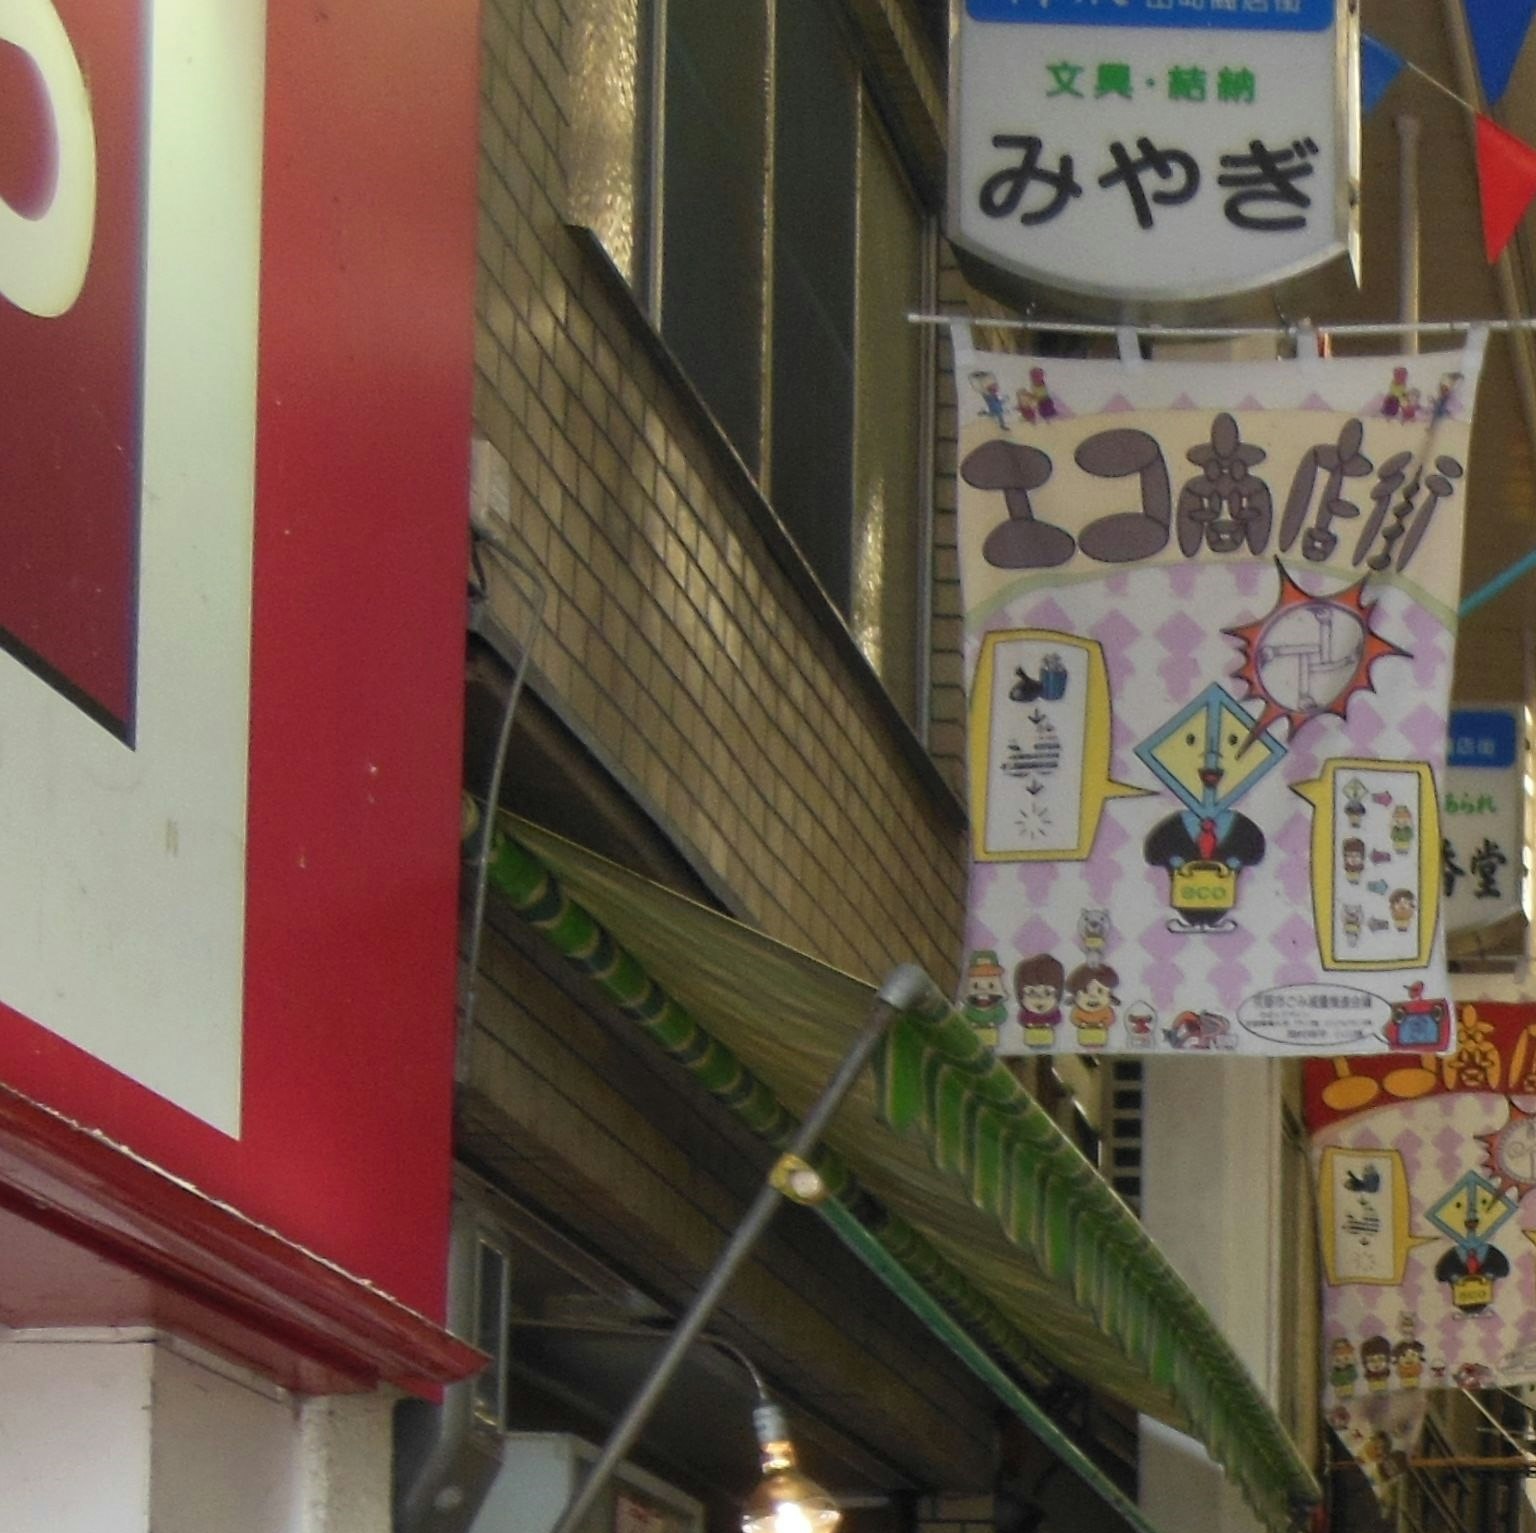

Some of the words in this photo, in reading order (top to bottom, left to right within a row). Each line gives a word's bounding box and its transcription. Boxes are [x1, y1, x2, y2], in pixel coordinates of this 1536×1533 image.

[1045, 61, 1256, 104] 文具・結納
[977, 133, 1320, 232] みやぎ
[960, 411, 1464, 573] エコ商店街
